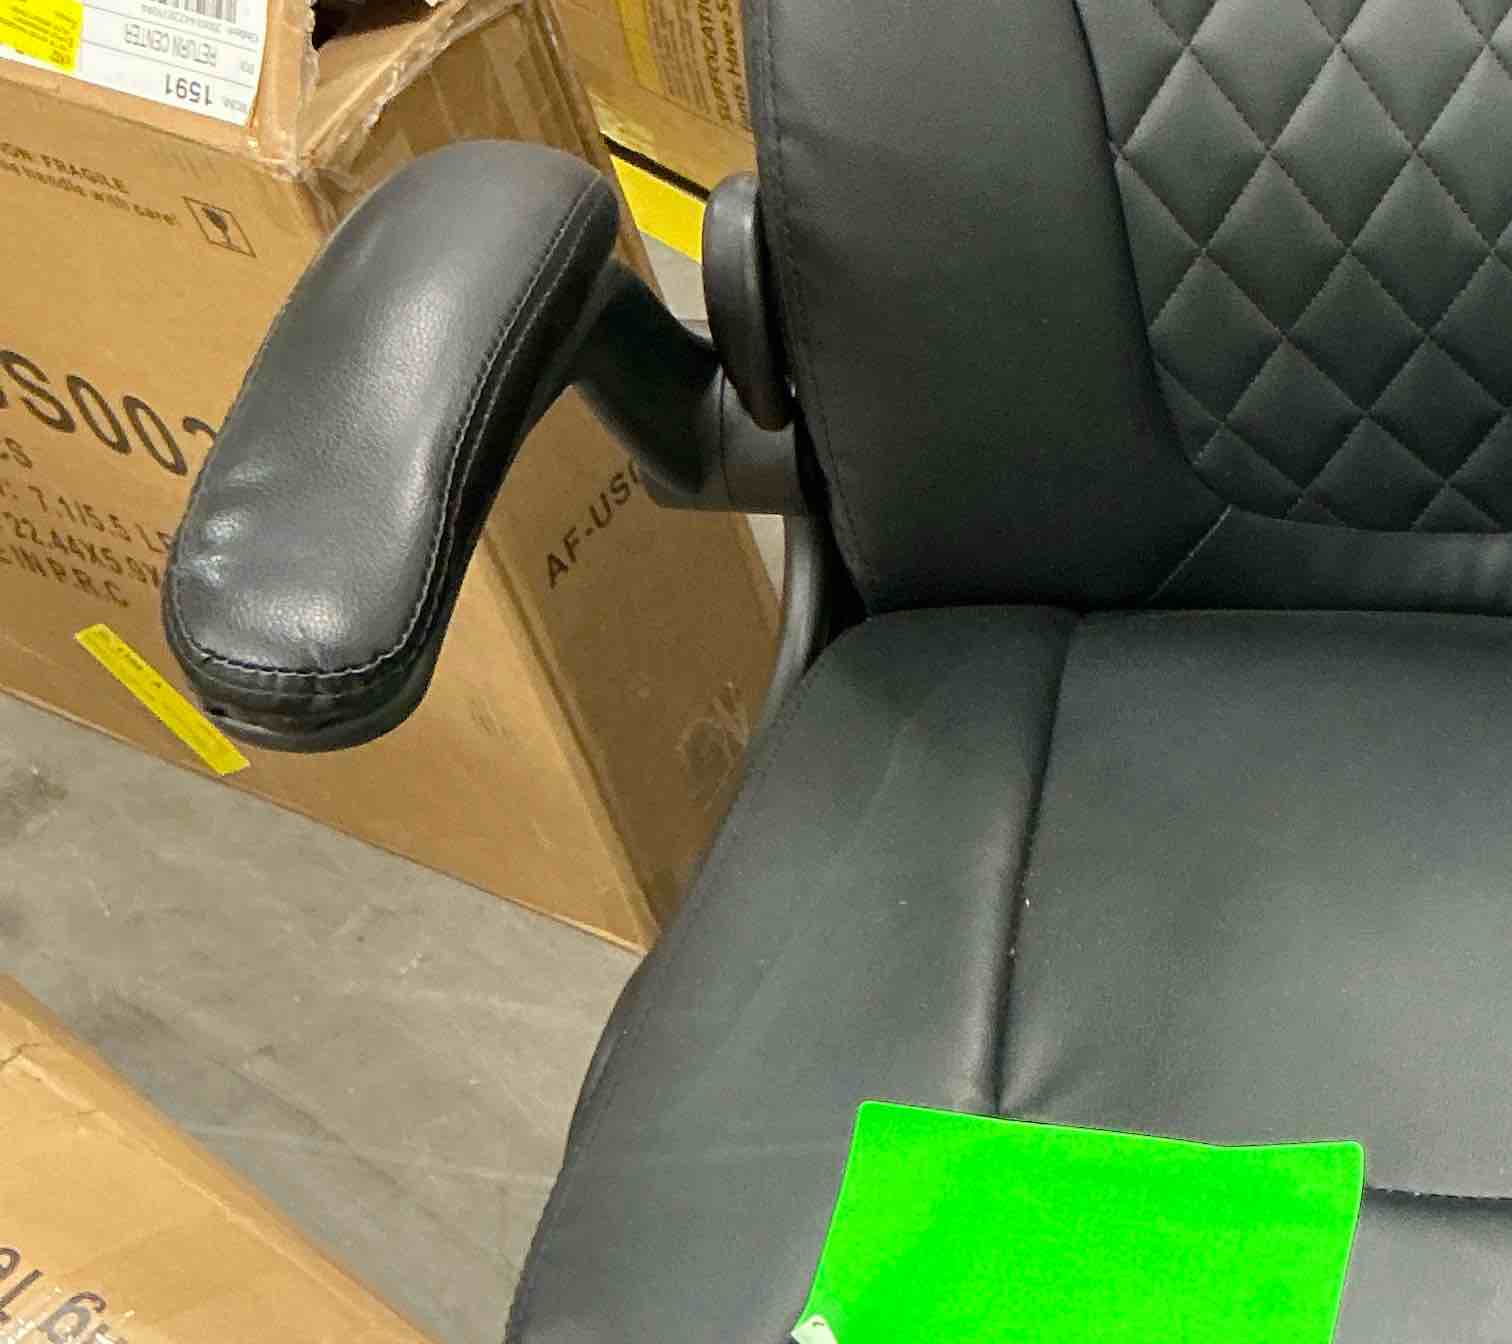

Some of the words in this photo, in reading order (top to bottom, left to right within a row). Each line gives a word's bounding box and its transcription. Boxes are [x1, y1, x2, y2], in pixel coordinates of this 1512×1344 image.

[123, 22, 171, 54] CENTER
[172, 35, 219, 68] RETURN
[722, 20, 742, 78] Have
[163, 73, 213, 107] 1591
[39, 153, 130, 195] FRAGILE
[0, 349, 217, 477] S00
